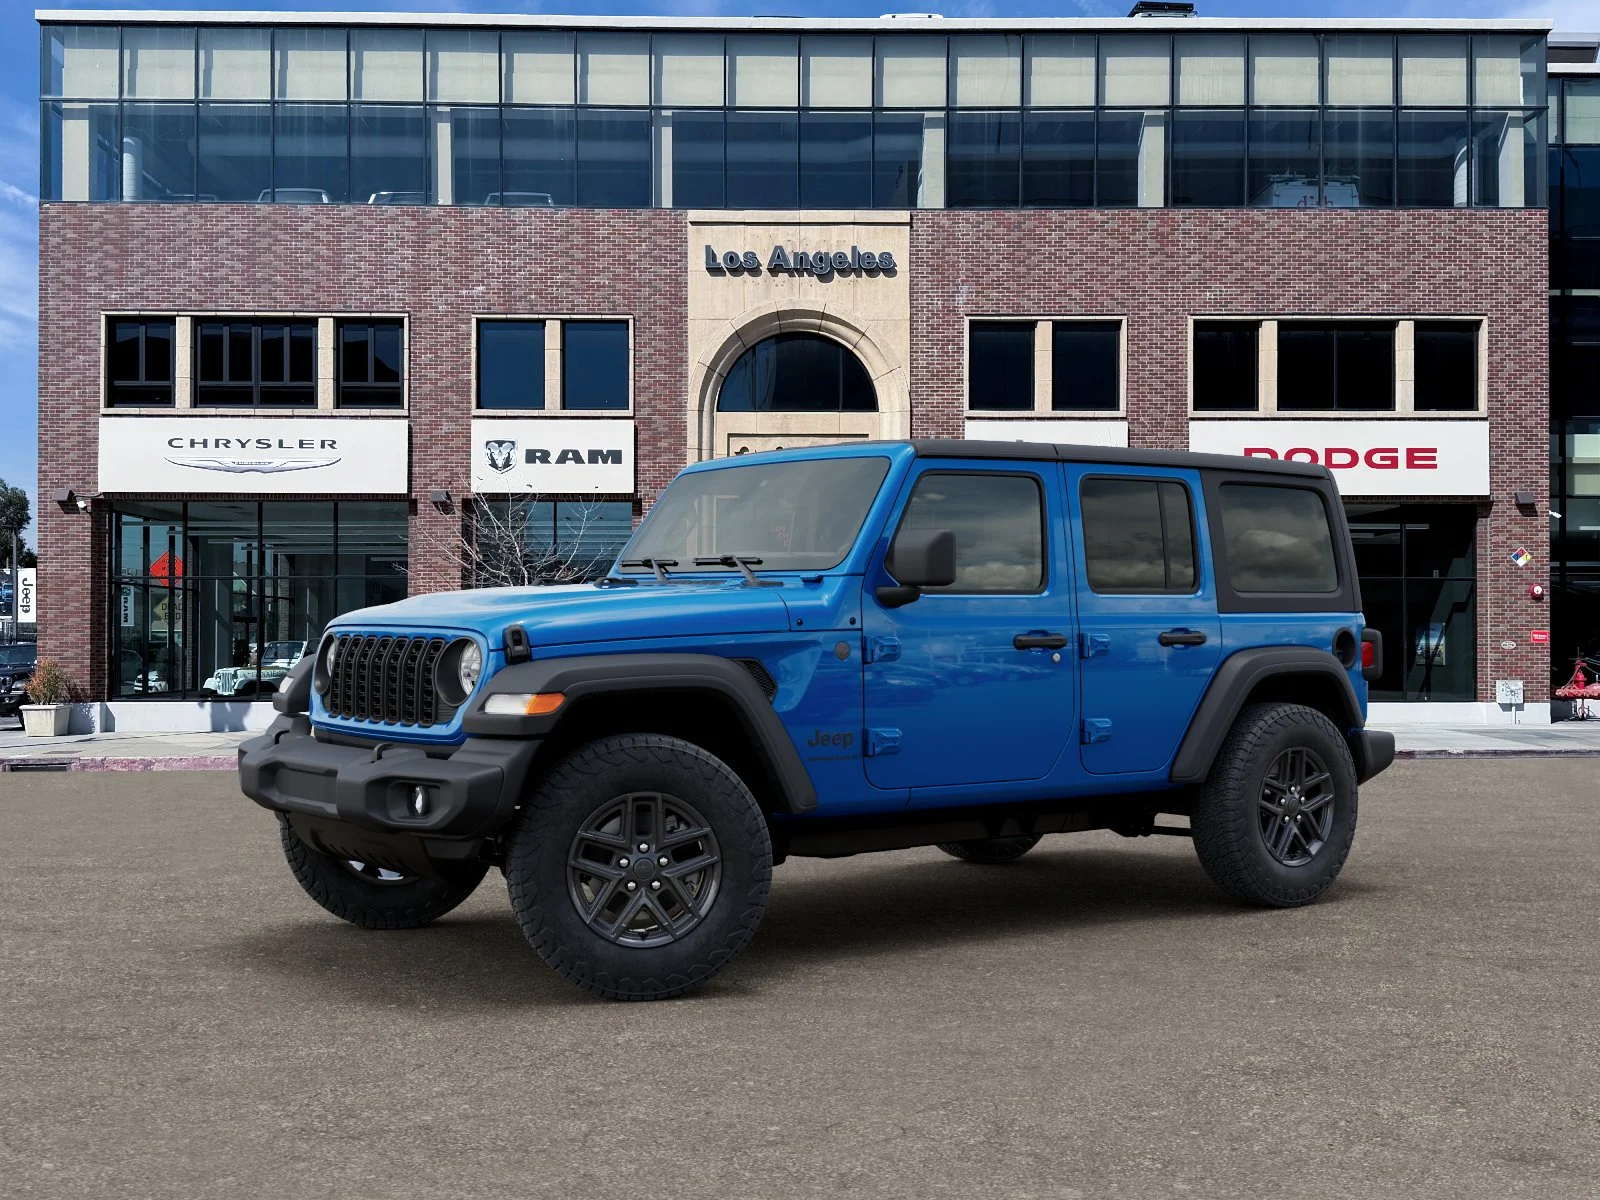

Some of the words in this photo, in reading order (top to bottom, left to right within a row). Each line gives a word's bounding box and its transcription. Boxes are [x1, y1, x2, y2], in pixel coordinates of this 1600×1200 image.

[1296, 195, 1334, 208] dih
[705, 244, 758, 269] Los
[767, 245, 895, 275] Angeles
[167, 437, 338, 450] CHRYSLER
[525, 448, 623, 465] RAM
[20, 577, 34, 614] Jeep
[161, 602, 183, 611] DAD
[164, 612, 181, 620] ED
[807, 729, 854, 748] Jeep
